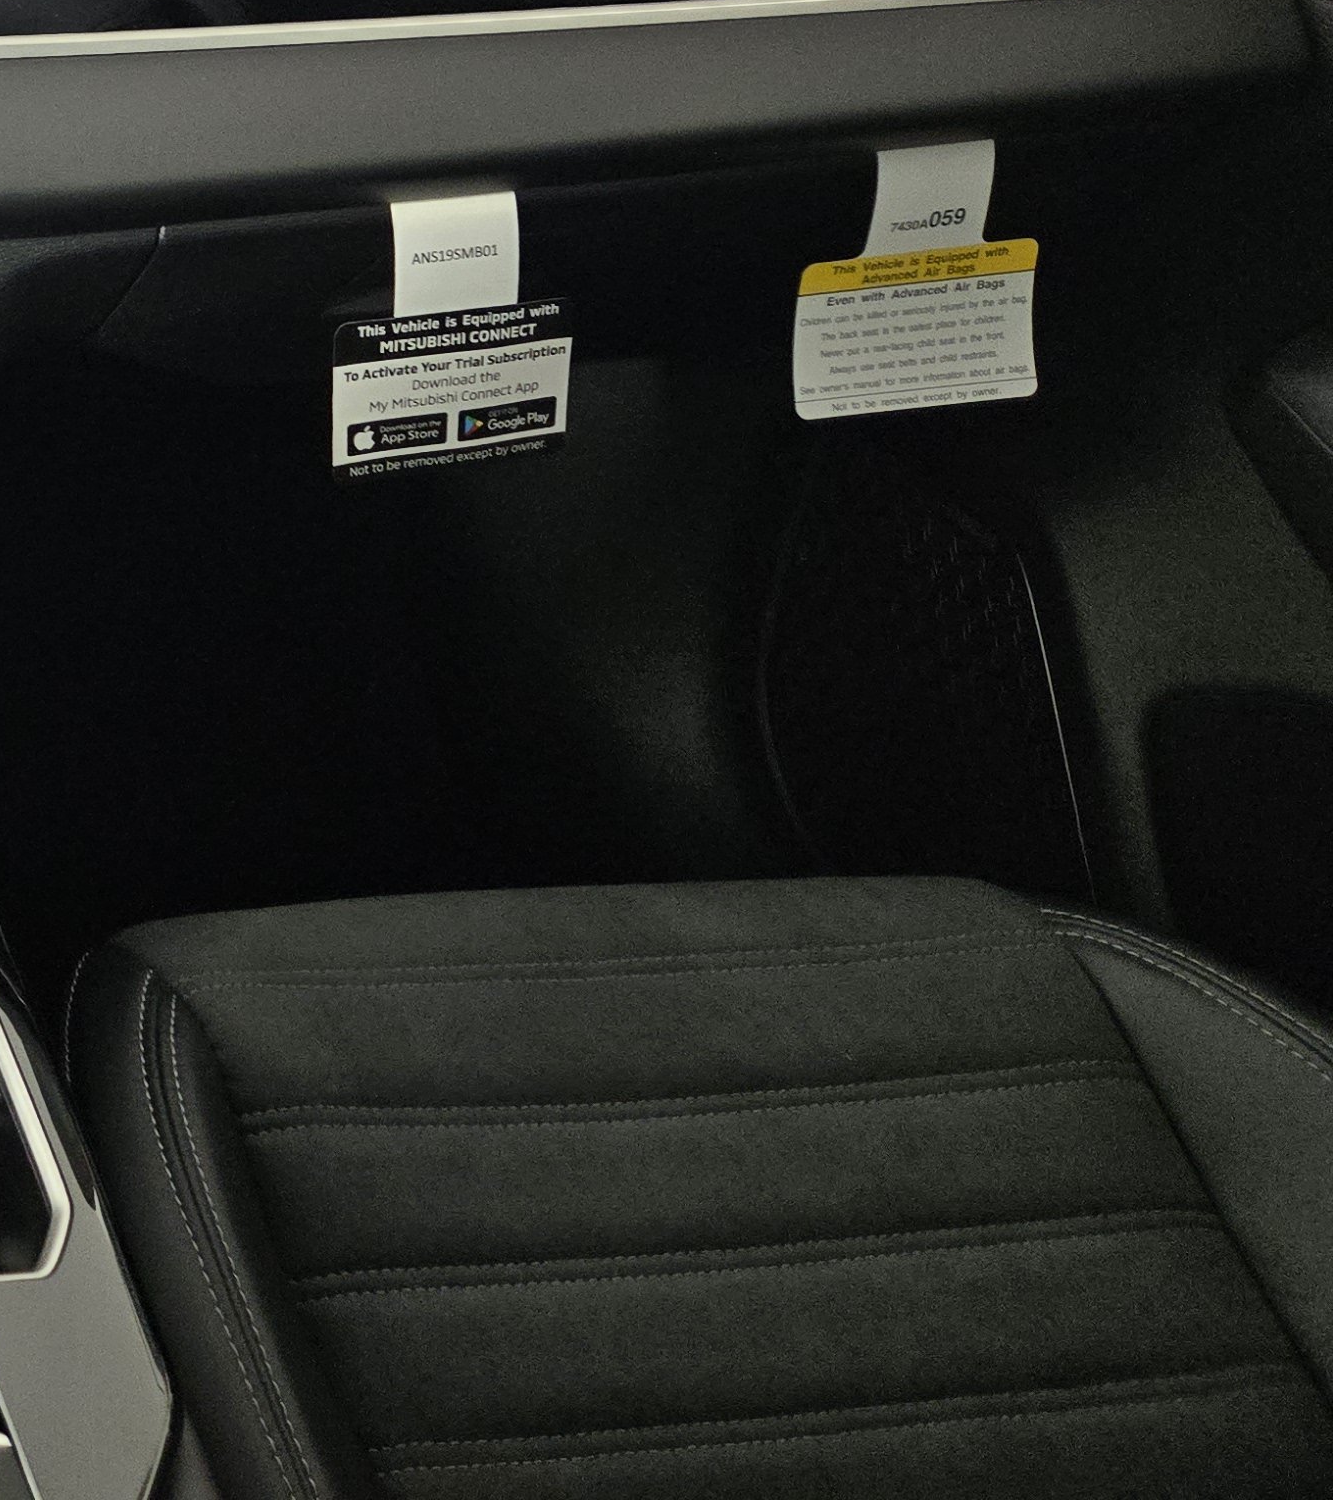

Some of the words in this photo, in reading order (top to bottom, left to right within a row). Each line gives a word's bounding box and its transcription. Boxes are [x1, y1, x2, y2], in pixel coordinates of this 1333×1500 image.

[832, 265, 856, 276] This
[863, 259, 905, 273] Vehicle
[910, 257, 921, 267] is
[926, 249, 980, 265] Equipped
[985, 246, 1010, 258] with
[861, 270, 918, 285] Advanced
[924, 267, 941, 278] Air
[947, 265, 976, 277] Bags
[826, 297, 856, 308] Even
[861, 293, 886, 304] with
[891, 285, 948, 299] Advanced
[954, 282, 971, 293] Air
[976, 279, 1006, 292] Bags
[358, 324, 386, 338] This
[392, 318, 440, 334] Vehicle
[445, 316, 458, 328] is
[462, 308, 525, 327] Equipped
[529, 304, 560, 318] with
[380, 332, 466, 354] MITSUBISHI
[470, 323, 537, 344] CONNECT
[345, 371, 359, 382] To
[362, 364, 418, 380] Activate
[421, 360, 451, 373] Your
[455, 356, 484, 369] Trial
[487, 345, 566, 366] Subscription
[412, 373, 476, 390] Download
[480, 370, 501, 383] the
[369, 401, 388, 414] My
[392, 392, 458, 410] Mitsubishi
[461, 385, 512, 402] Connect
[515, 381, 539, 394] App
[488, 414, 526, 431] Google
[527, 411, 550, 426] Play
[380, 430, 406, 445] App
[408, 428, 439, 440] Store
[350, 466, 369, 477] Not
[372, 463, 384, 474] to
[386, 459, 401, 471] be
[403, 452, 454, 469] removed
[456, 448, 493, 464] except
[495, 445, 508, 457] by
